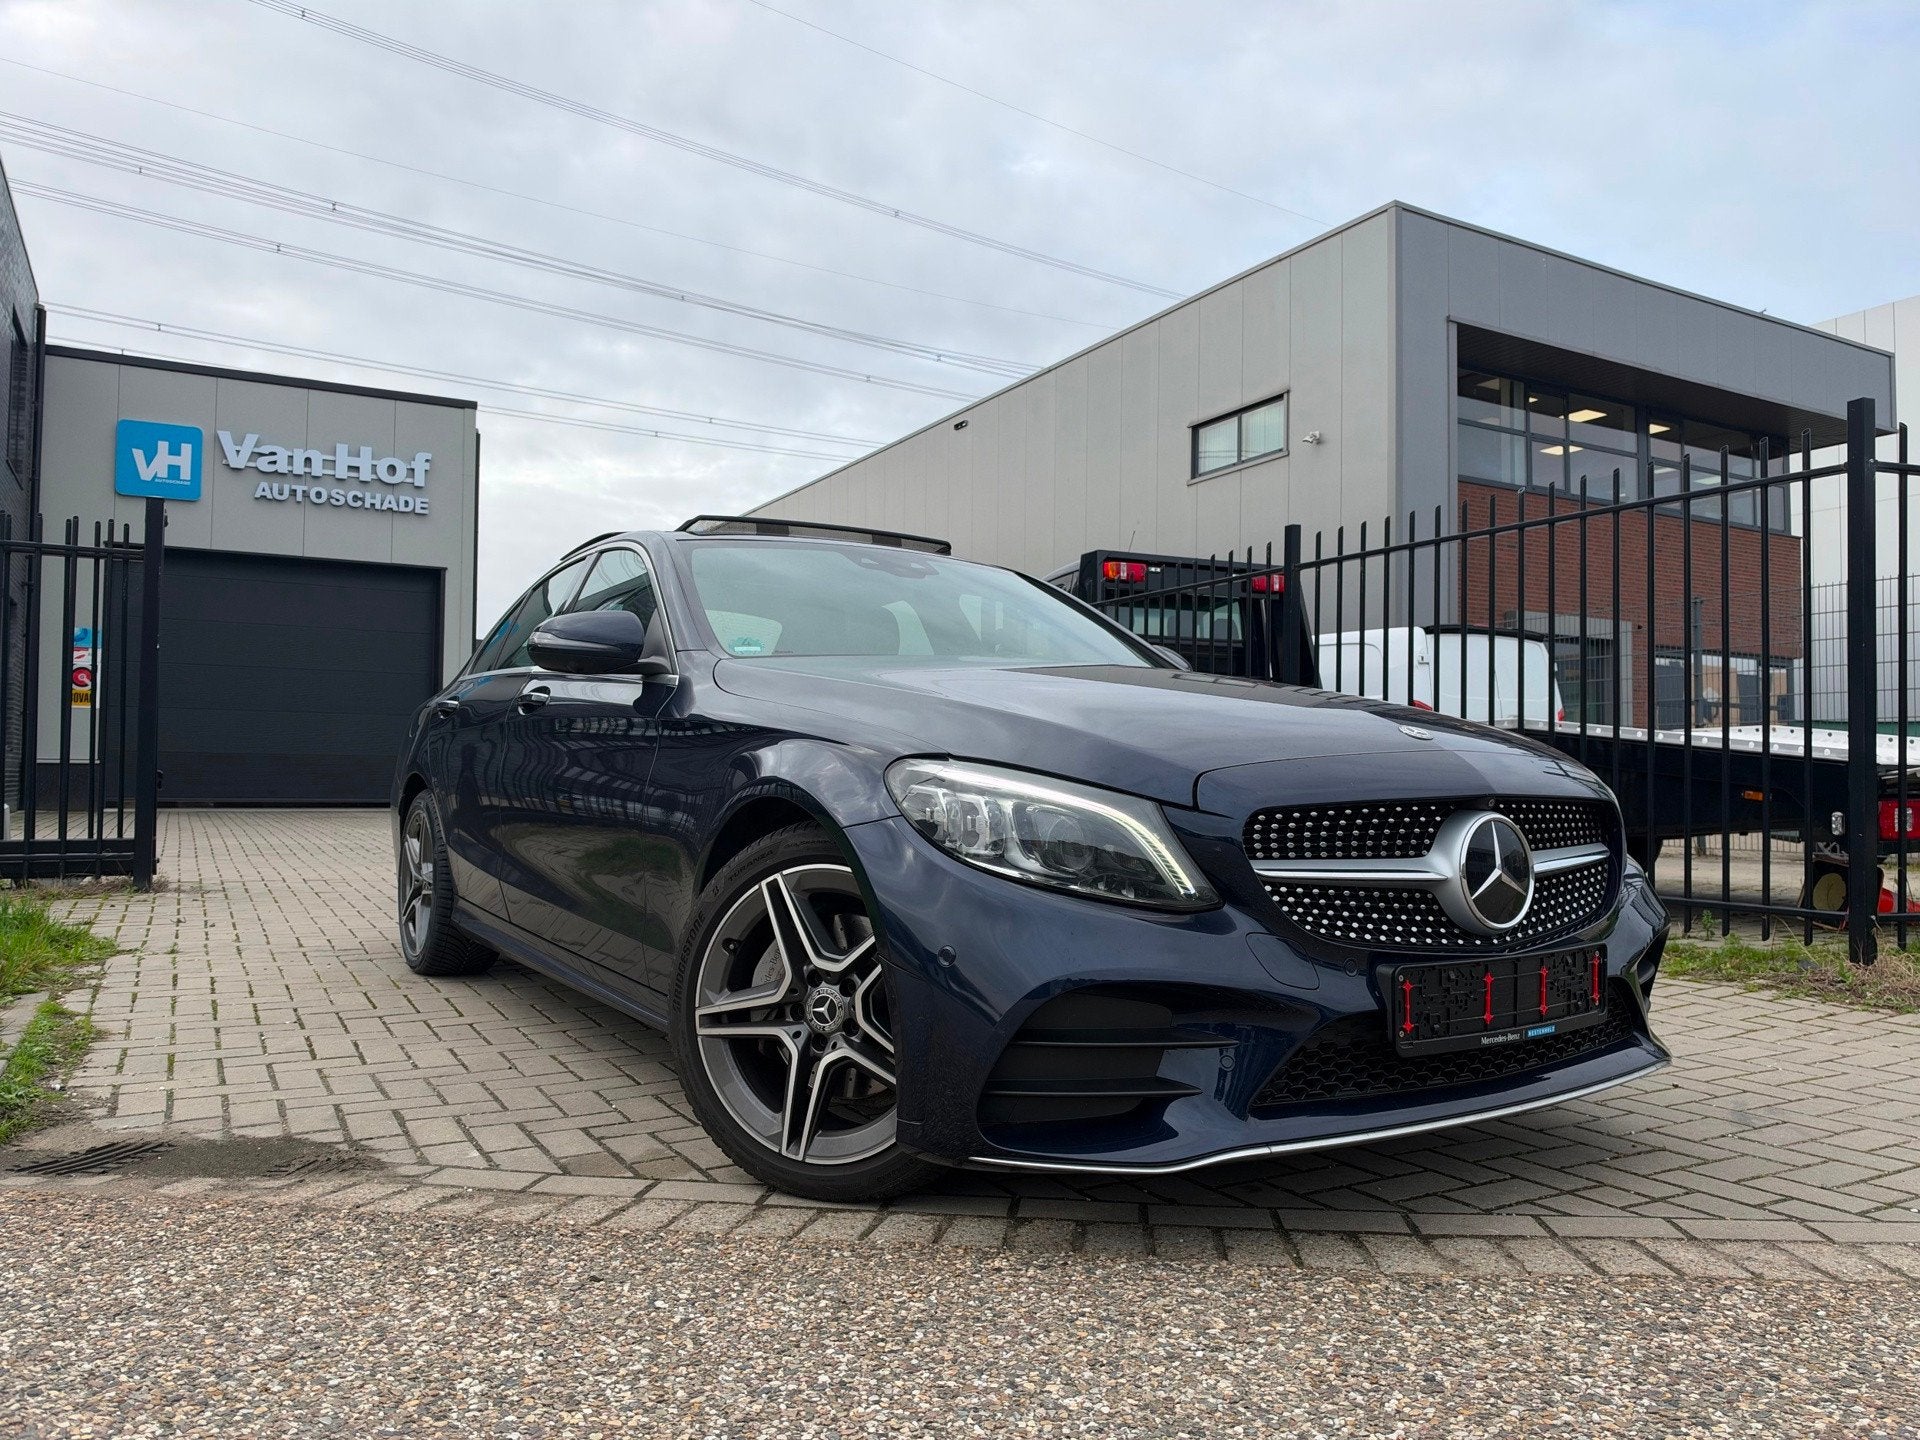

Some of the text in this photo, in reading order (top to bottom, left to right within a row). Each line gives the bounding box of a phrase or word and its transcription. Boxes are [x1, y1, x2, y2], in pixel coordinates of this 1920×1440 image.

[154, 478, 191, 486] AUTOSCHADE
[254, 482, 429, 514] AUTOSCHADE
[1481, 1032, 1521, 1045] Mercedes-Benz
